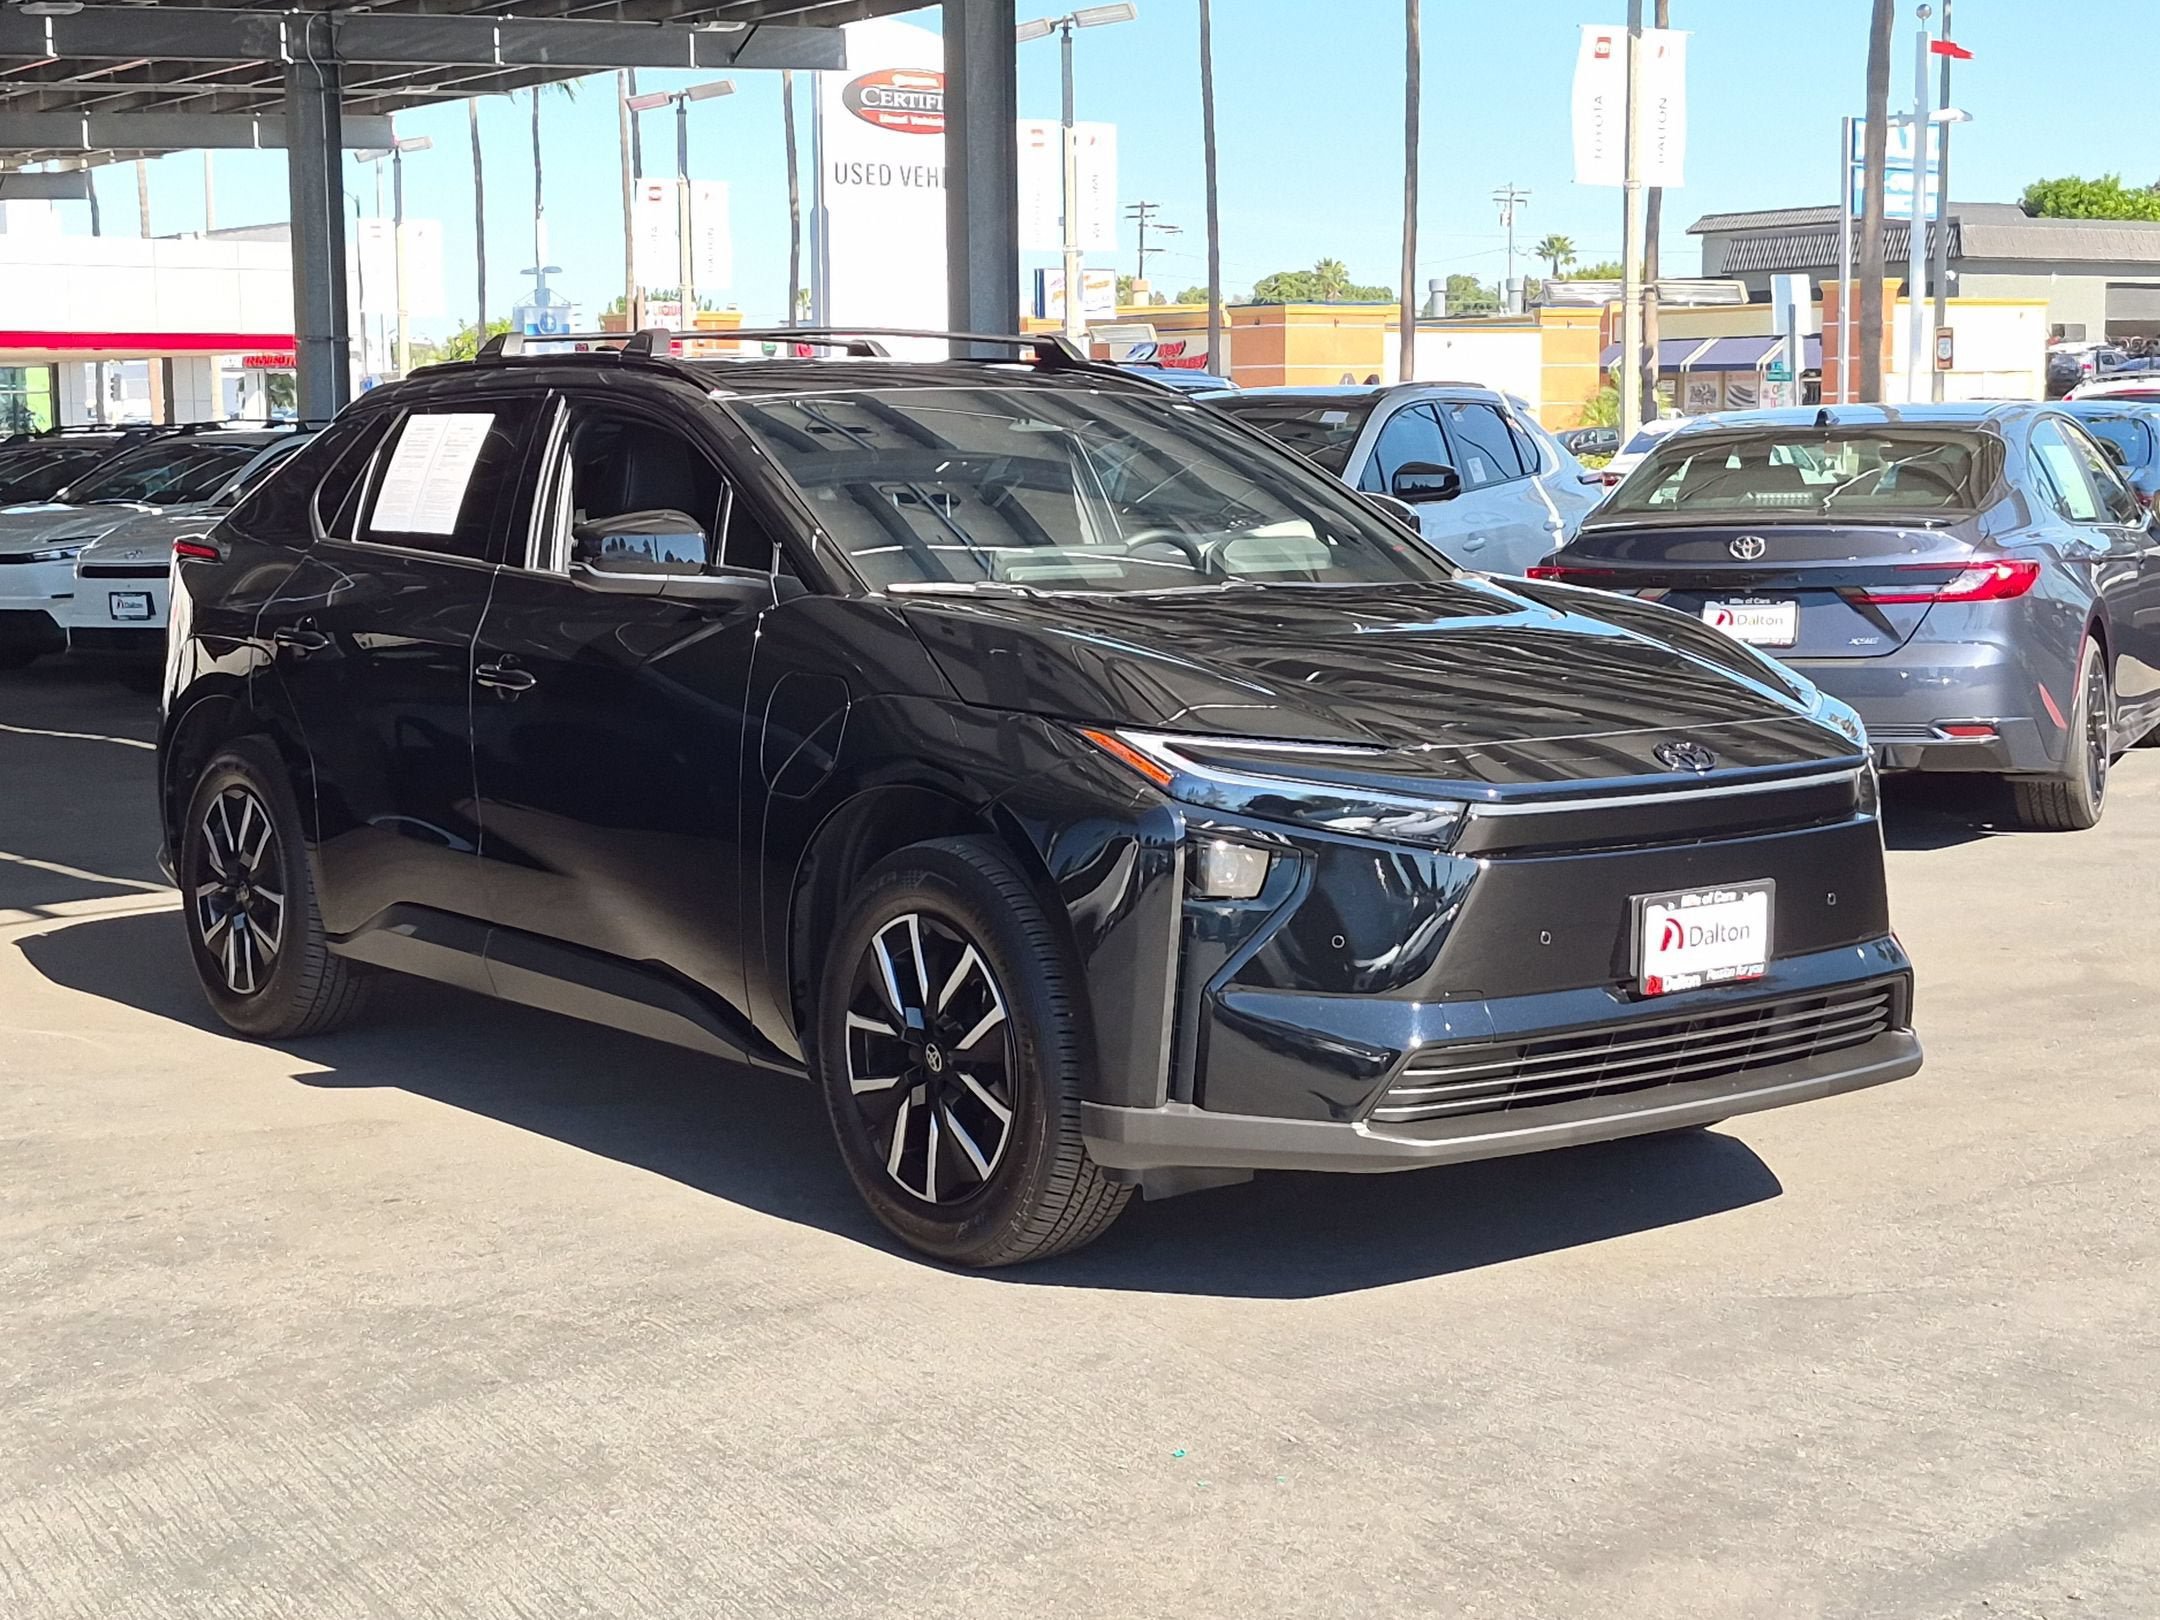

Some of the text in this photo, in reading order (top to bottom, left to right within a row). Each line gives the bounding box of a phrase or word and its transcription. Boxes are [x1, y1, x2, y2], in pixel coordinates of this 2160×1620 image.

[835, 161, 891, 186] USED
[1737, 614, 1784, 625] Dalton
[1702, 892, 1713, 904] of
[1714, 891, 1737, 903] Cars
[1689, 922, 1750, 947] Dalton
